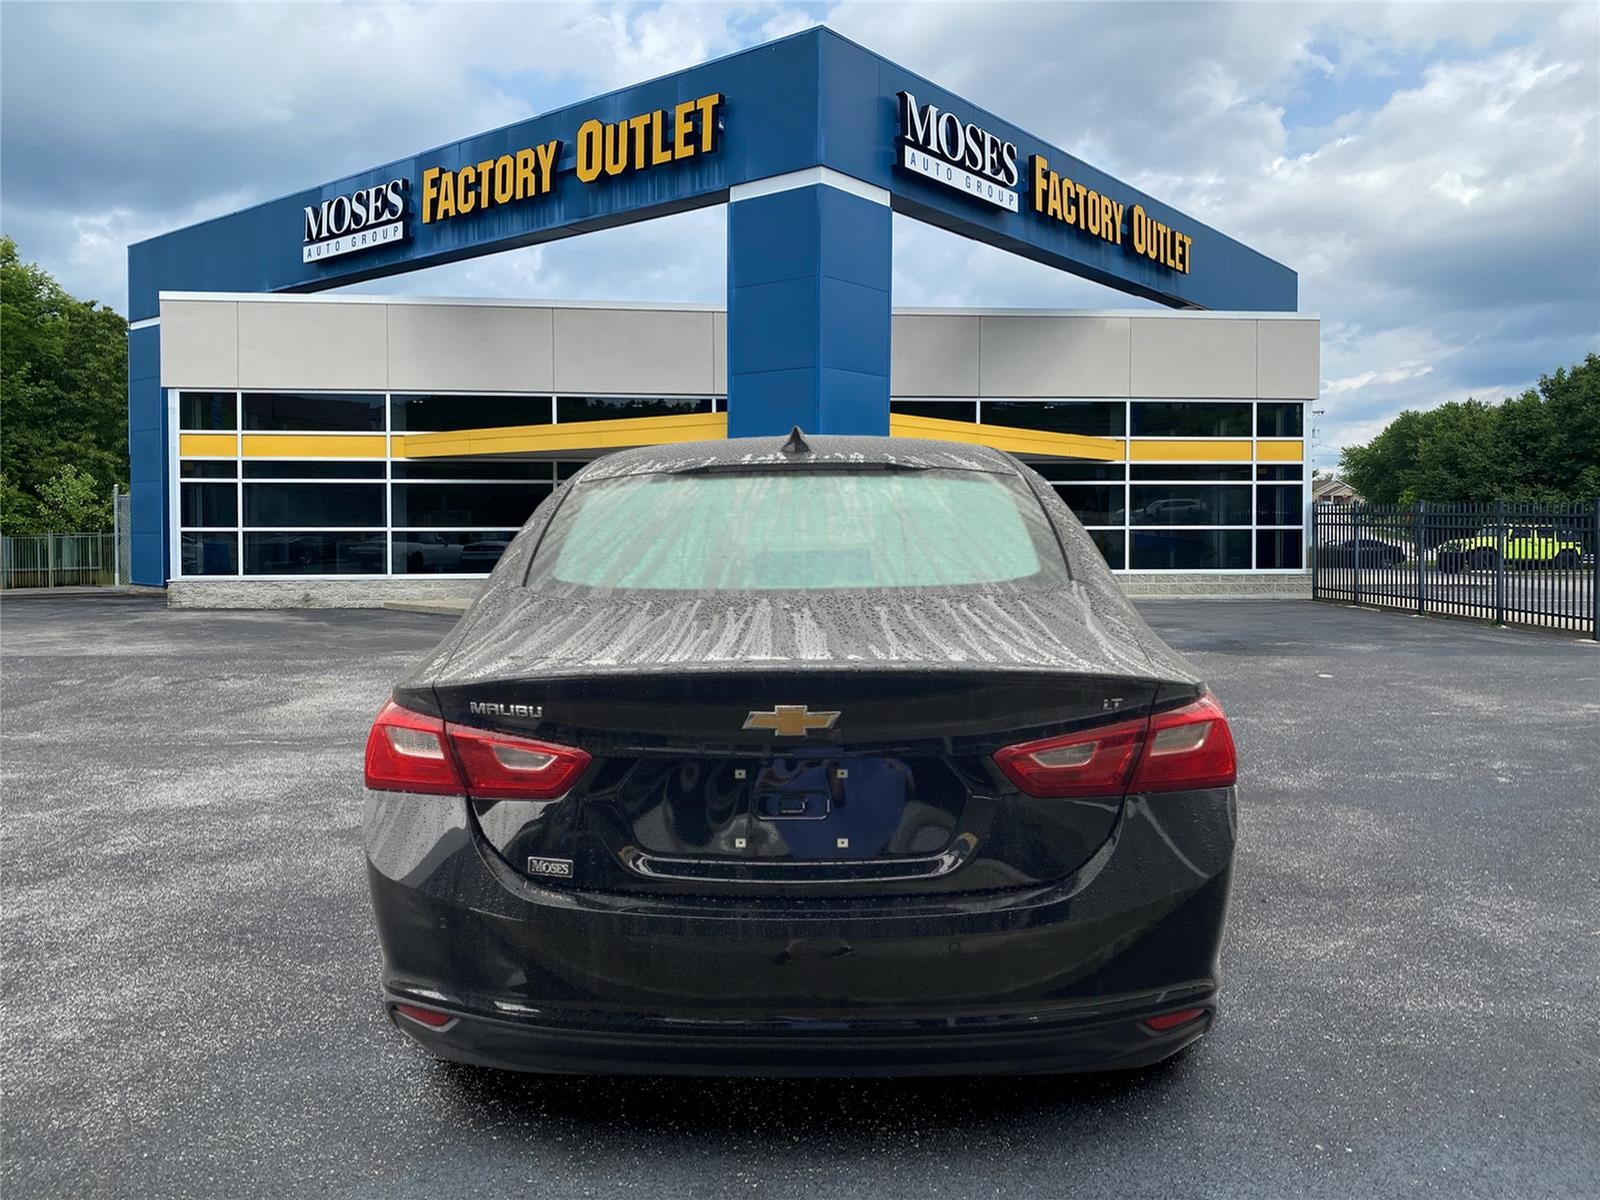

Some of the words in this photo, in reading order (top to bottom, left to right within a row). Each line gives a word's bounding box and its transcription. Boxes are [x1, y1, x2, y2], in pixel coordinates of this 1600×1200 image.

[421, 139, 559, 225] FACTORY
[576, 92, 721, 183] OUTLET
[903, 90, 1018, 187] MOSES
[910, 151, 953, 182] AUTO
[965, 175, 1015, 206] GROUP
[303, 178, 404, 243] MOSES
[1034, 153, 1124, 245] FACTORY
[1132, 203, 1192, 275] OUTLET
[306, 240, 341, 259] AUTO
[350, 225, 400, 249] GROUP
[469, 701, 543, 718] MALIBU
[1103, 698, 1123, 711] LT
[531, 858, 570, 875] MOSES
